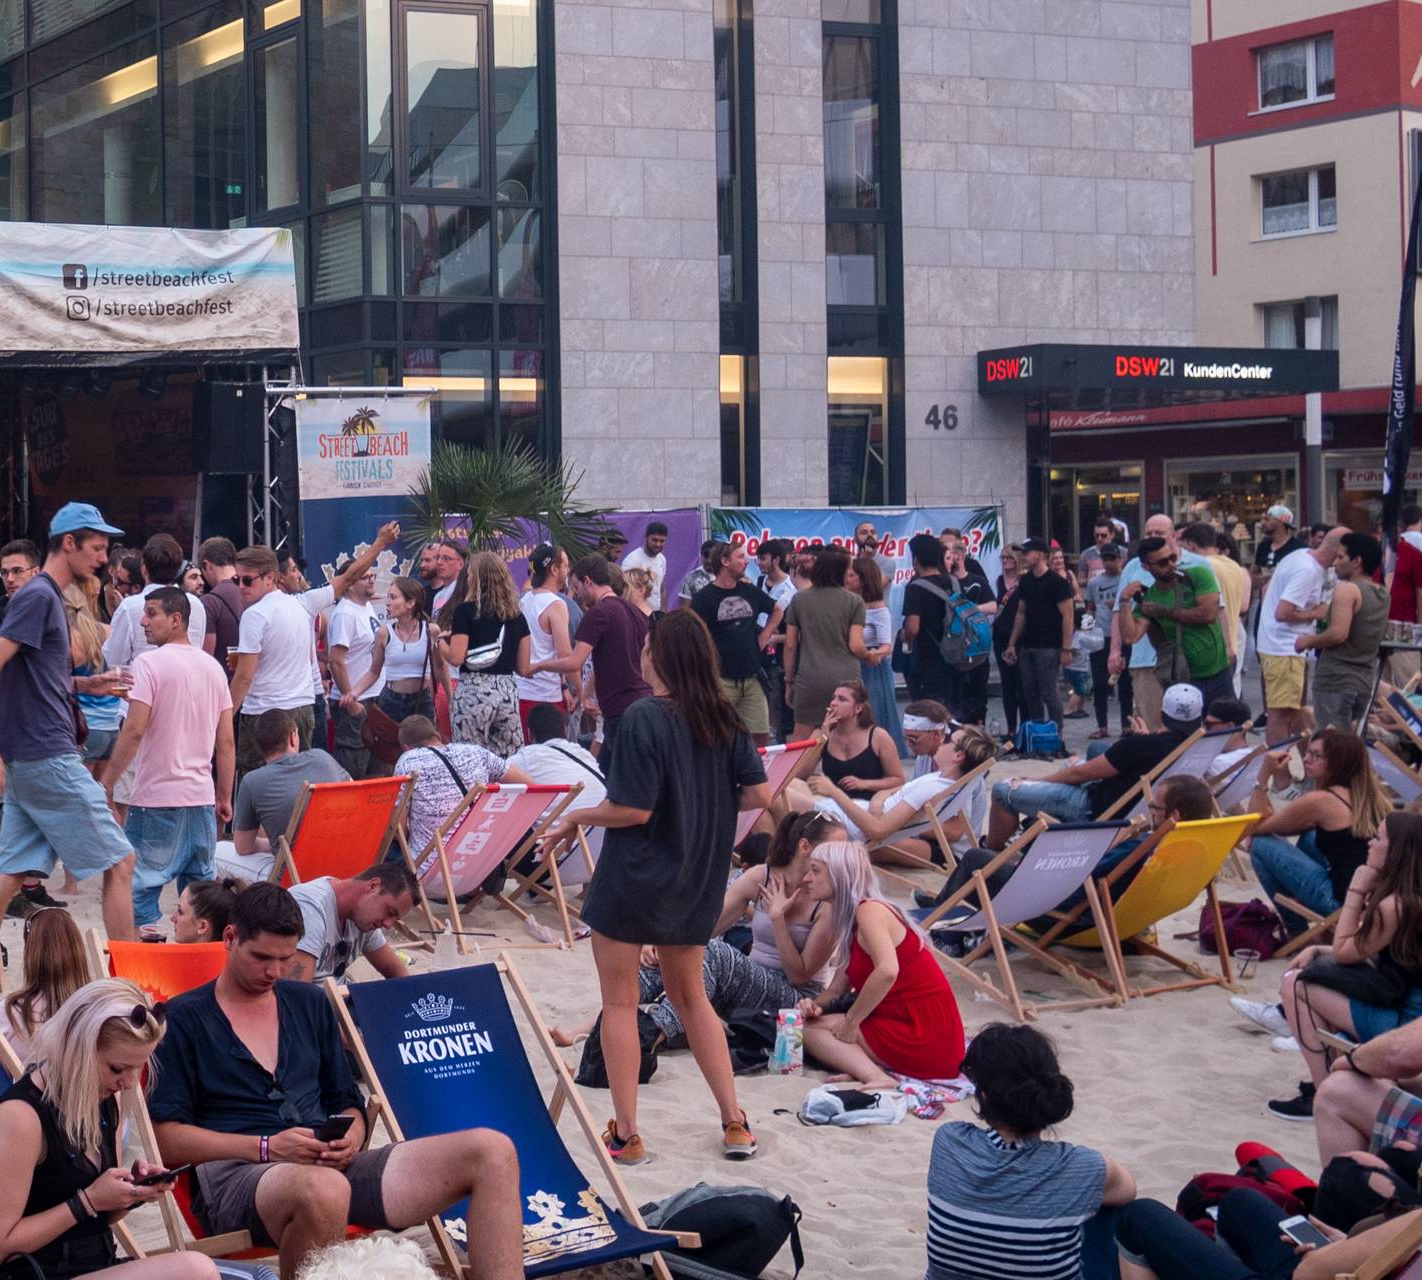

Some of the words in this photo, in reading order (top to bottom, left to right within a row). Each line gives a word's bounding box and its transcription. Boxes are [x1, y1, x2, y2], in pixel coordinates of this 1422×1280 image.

[93, 268, 234, 287] /streetbeachfest
[96, 298, 234, 316] /streetbeachfest
[986, 356, 1033, 382] DSW21
[1116, 355, 1174, 377] DSW21
[1184, 362, 1273, 379] KundenCenter
[924, 404, 959, 430] 46
[318, 433, 354, 459] STREET
[370, 431, 408, 456] BEACH
[335, 458, 393, 481] FESTIVALS
[404, 1021, 477, 1040] DORTMUNDER
[397, 1030, 494, 1065] KRONEN
